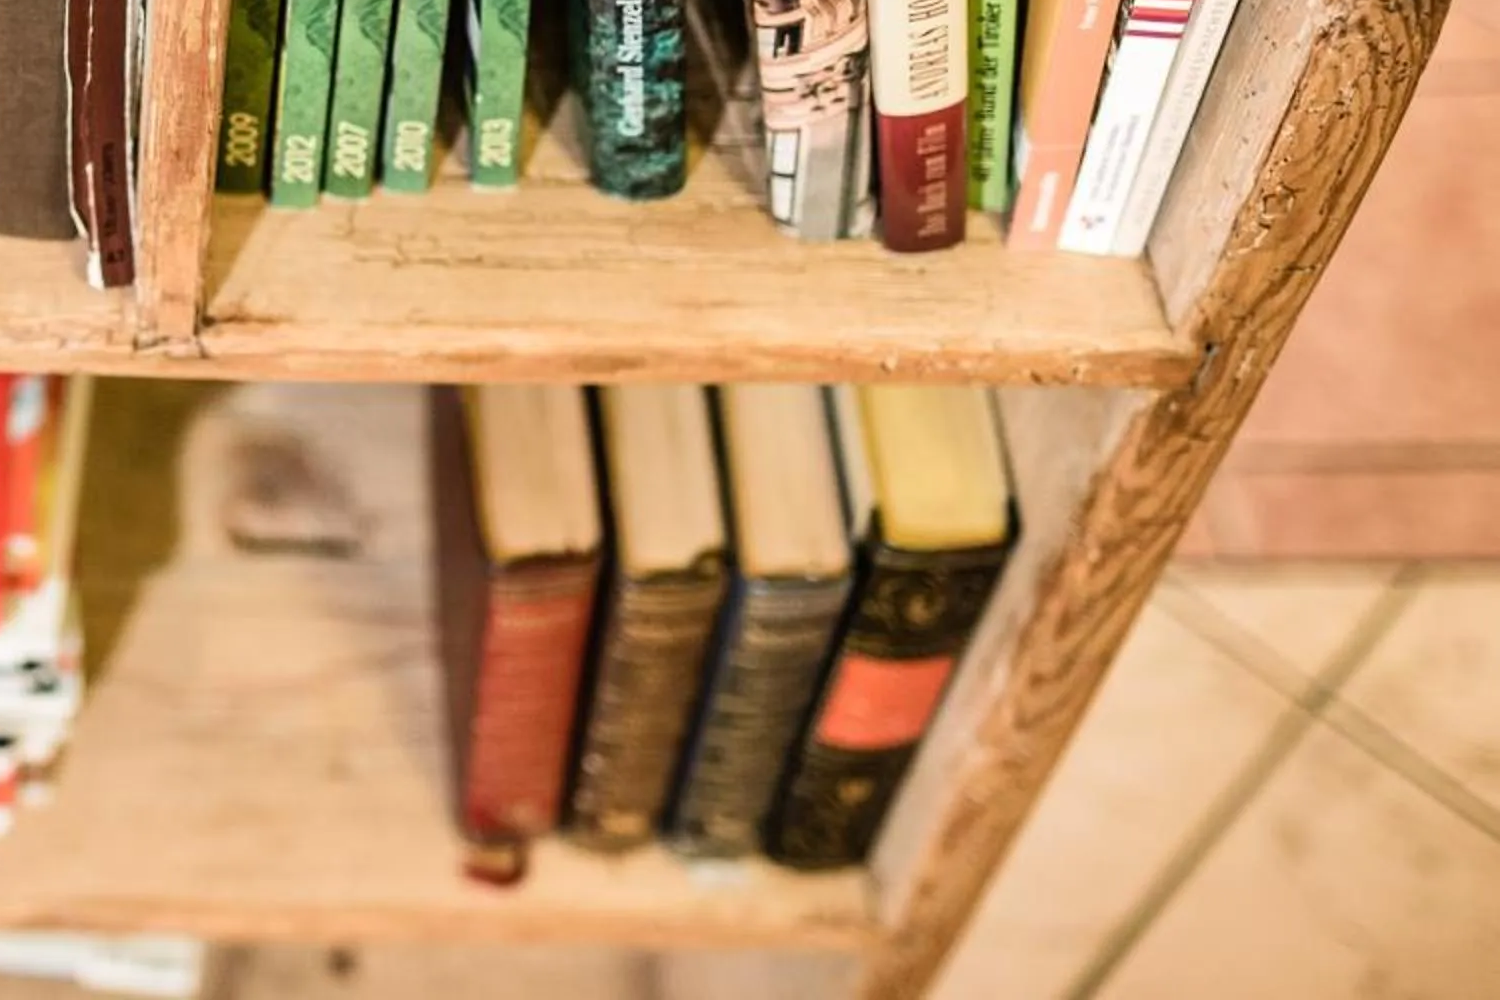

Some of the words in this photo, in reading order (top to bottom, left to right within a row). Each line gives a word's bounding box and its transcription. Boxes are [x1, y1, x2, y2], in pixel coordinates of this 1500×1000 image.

[976, 1, 1002, 51] Tiroler
[909, 24, 948, 100] ANDREAS
[226, 112, 259, 168] 2009
[283, 134, 316, 185] 2012
[333, 121, 369, 180] 2007
